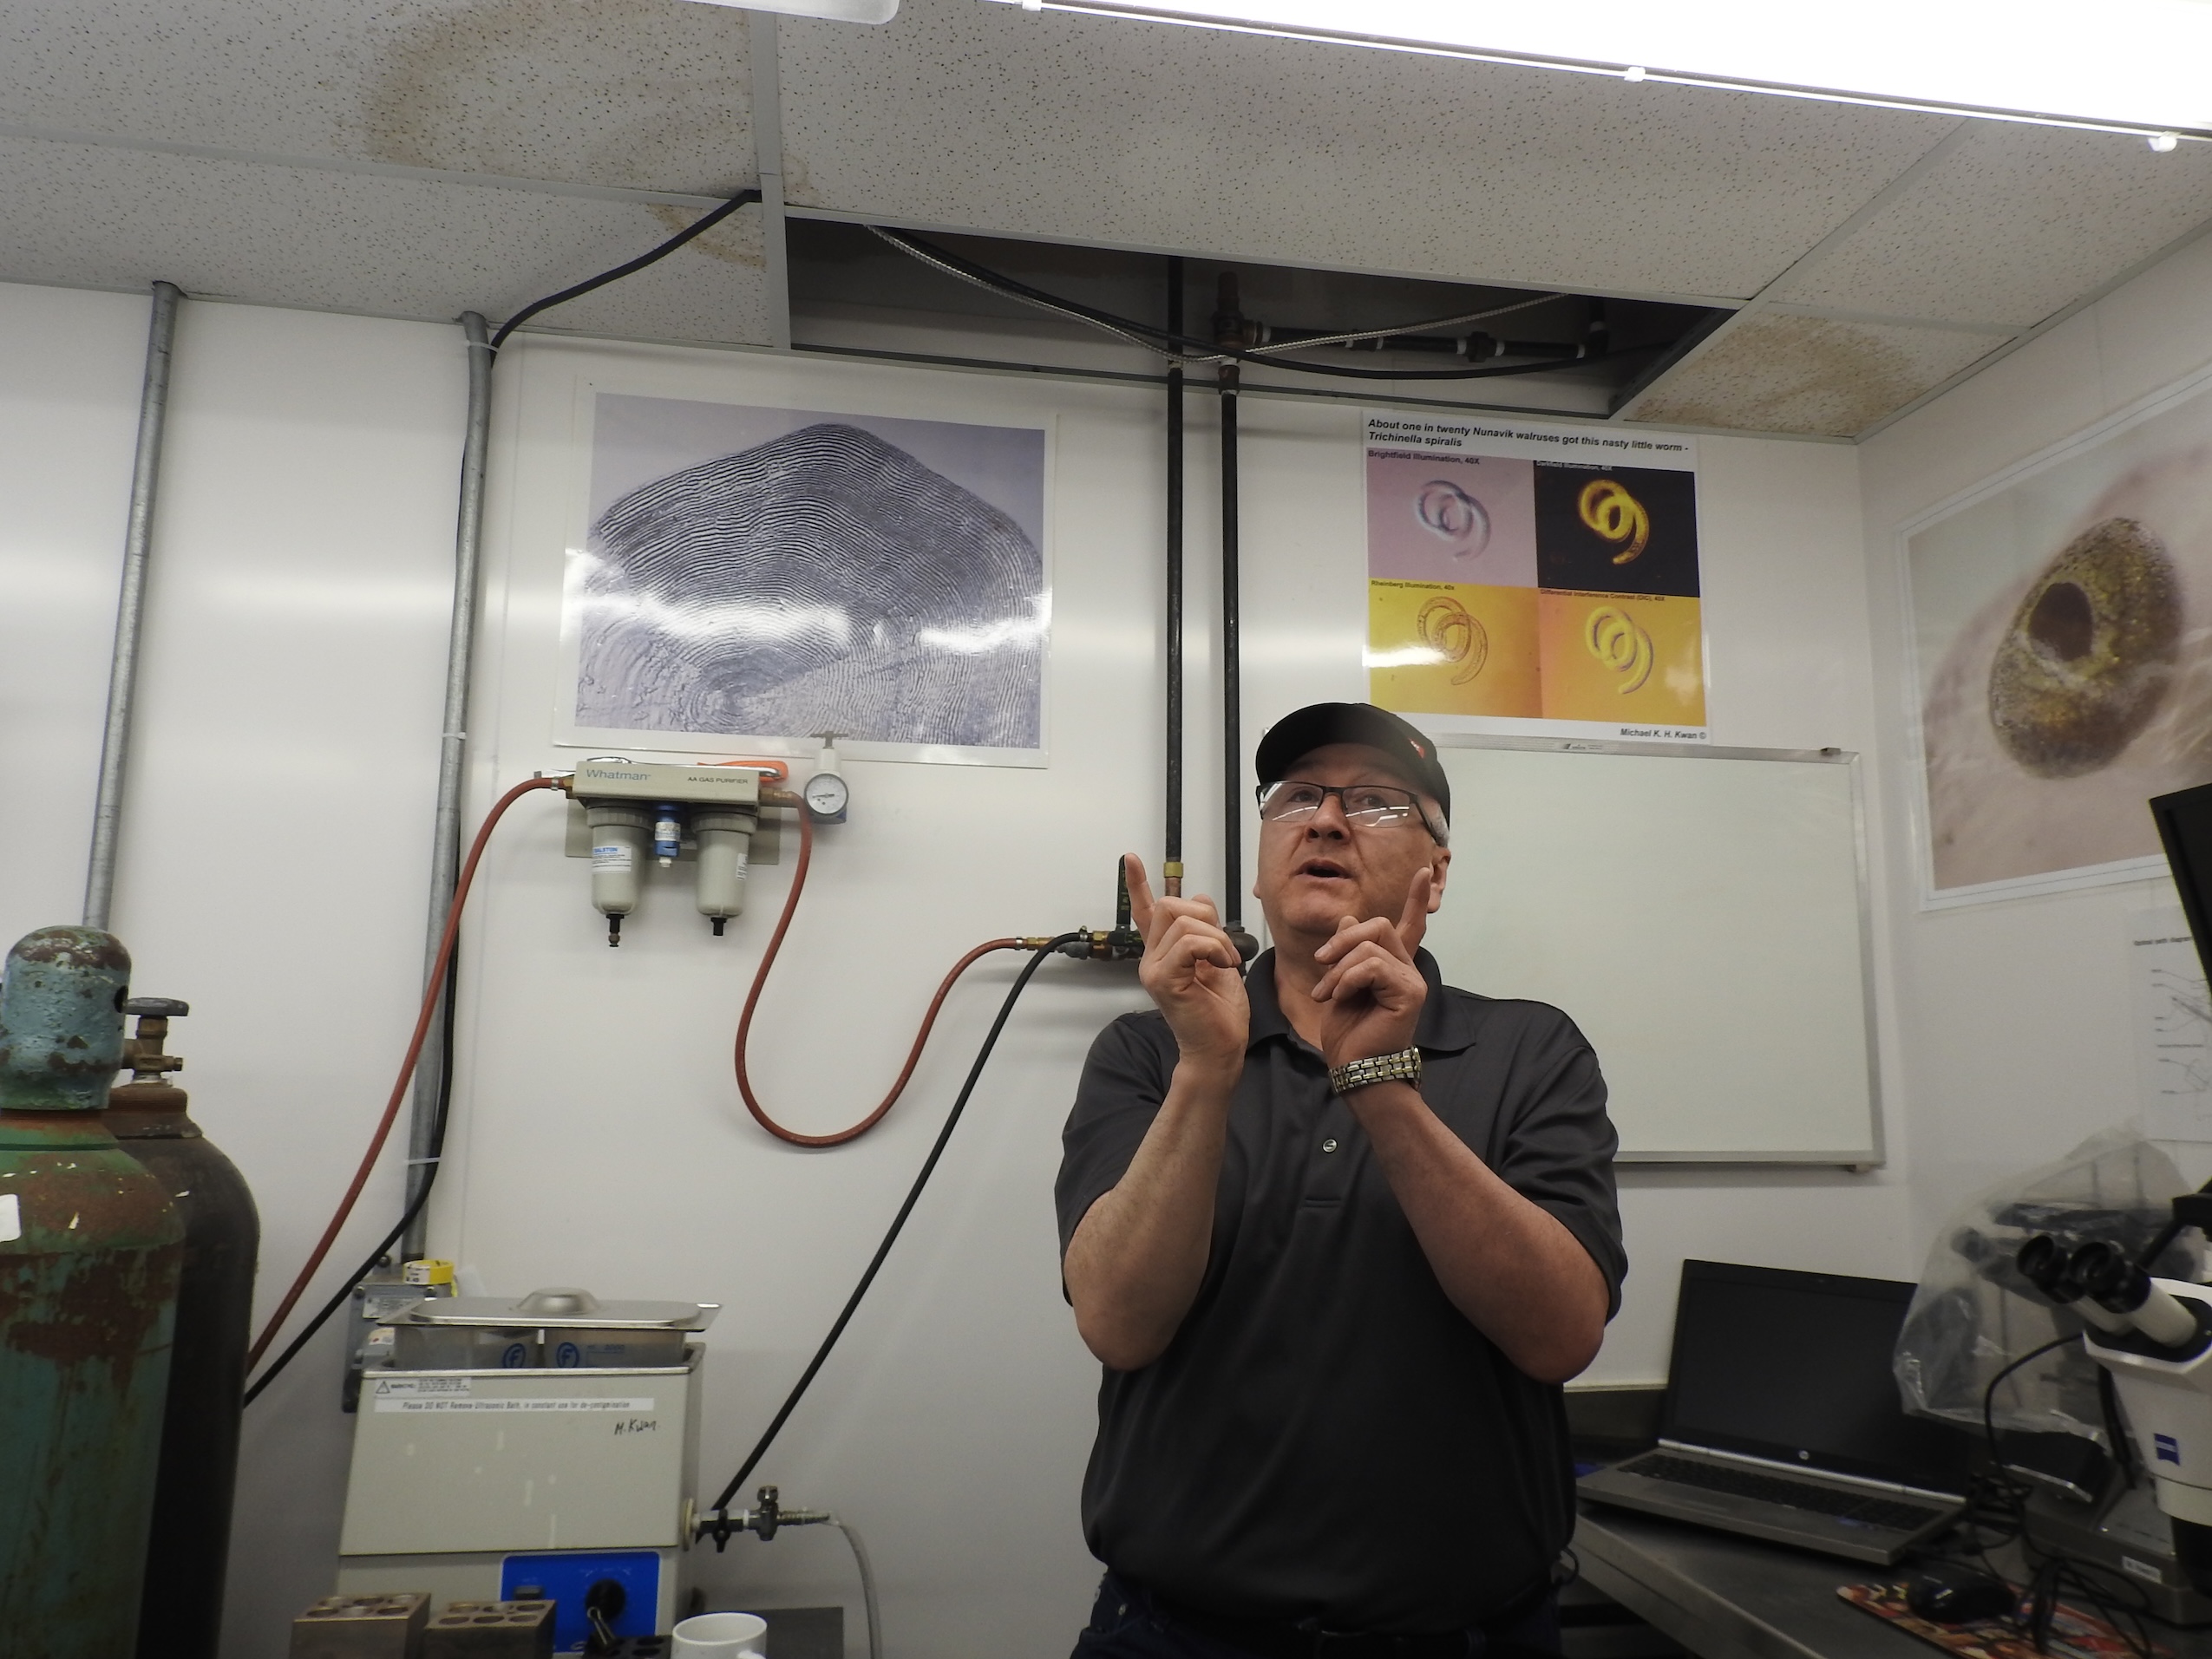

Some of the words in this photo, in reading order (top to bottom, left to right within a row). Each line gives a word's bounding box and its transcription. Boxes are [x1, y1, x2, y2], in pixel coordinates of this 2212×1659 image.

[1368, 419, 1400, 430] About
[1403, 422, 1422, 431] one
[1424, 423, 1434, 432] in
[1436, 425, 1470, 436] twenty
[1473, 428, 1513, 439] Nunavik
[1516, 432, 1560, 442] walruses
[1562, 436, 1579, 445] got
[1581, 437, 1600, 446] this
[1602, 440, 1629, 449] nasty
[1632, 441, 1652, 449] little
[1655, 443, 1682, 452] worm
[1369, 431, 1422, 444] Trichinella
[1424, 436, 1463, 447] spiralis
[1368, 450, 1411, 460] Brightfield
[1413, 454, 1463, 464] Illumination,
[1620, 728, 1652, 737] Michael
[586, 768, 648, 781] Whatman
